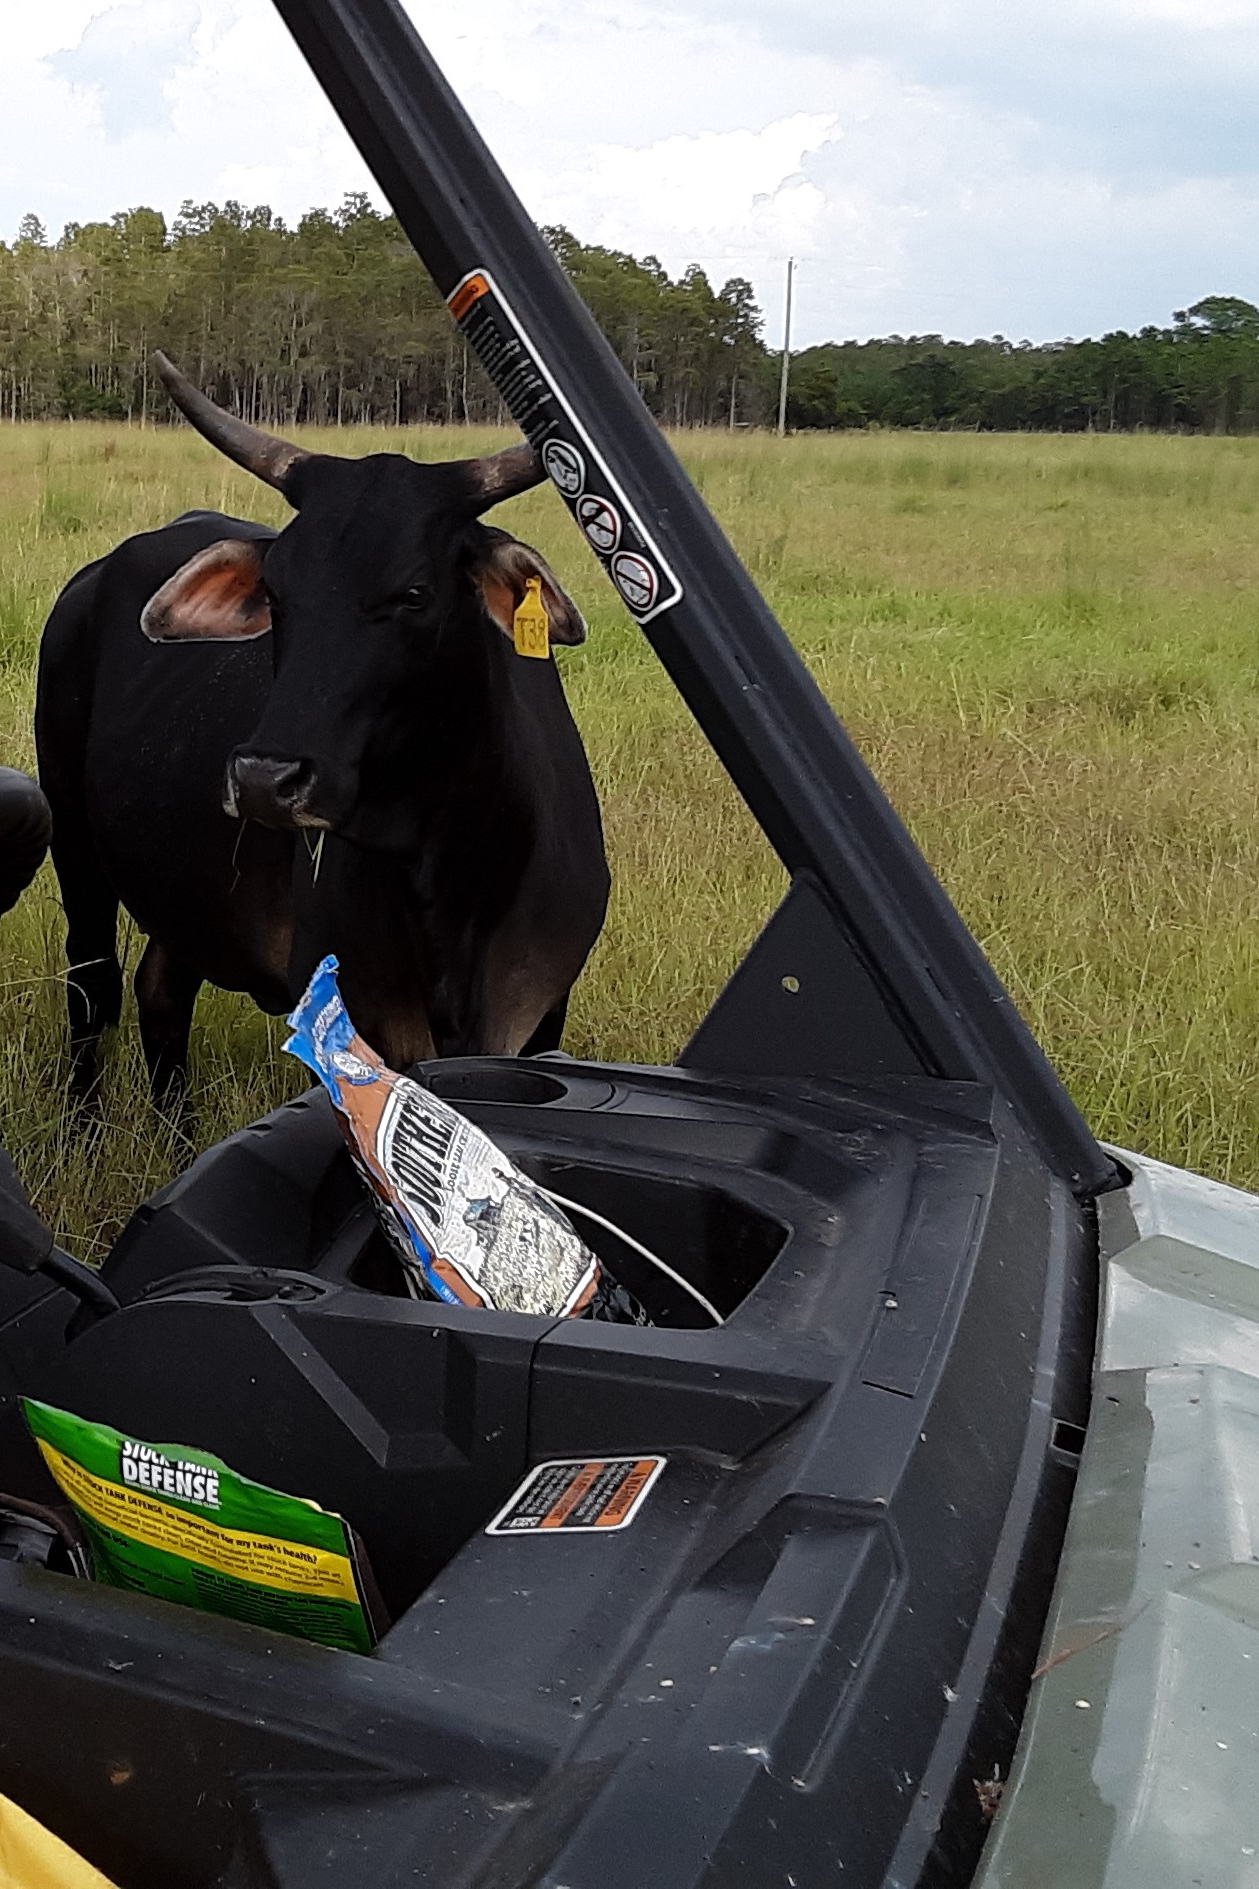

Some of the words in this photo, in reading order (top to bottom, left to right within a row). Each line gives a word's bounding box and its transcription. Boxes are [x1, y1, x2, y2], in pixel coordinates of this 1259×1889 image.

[516, 617, 546, 649] T38
[387, 1086, 458, 1228] SOUTHE
[122, 1457, 219, 1504] DEFENSE
[106, 1487, 126, 1502] TANK
[176, 1516, 220, 1538] important
[252, 1541, 282, 1554] tank's
[283, 1547, 318, 1564] health?
